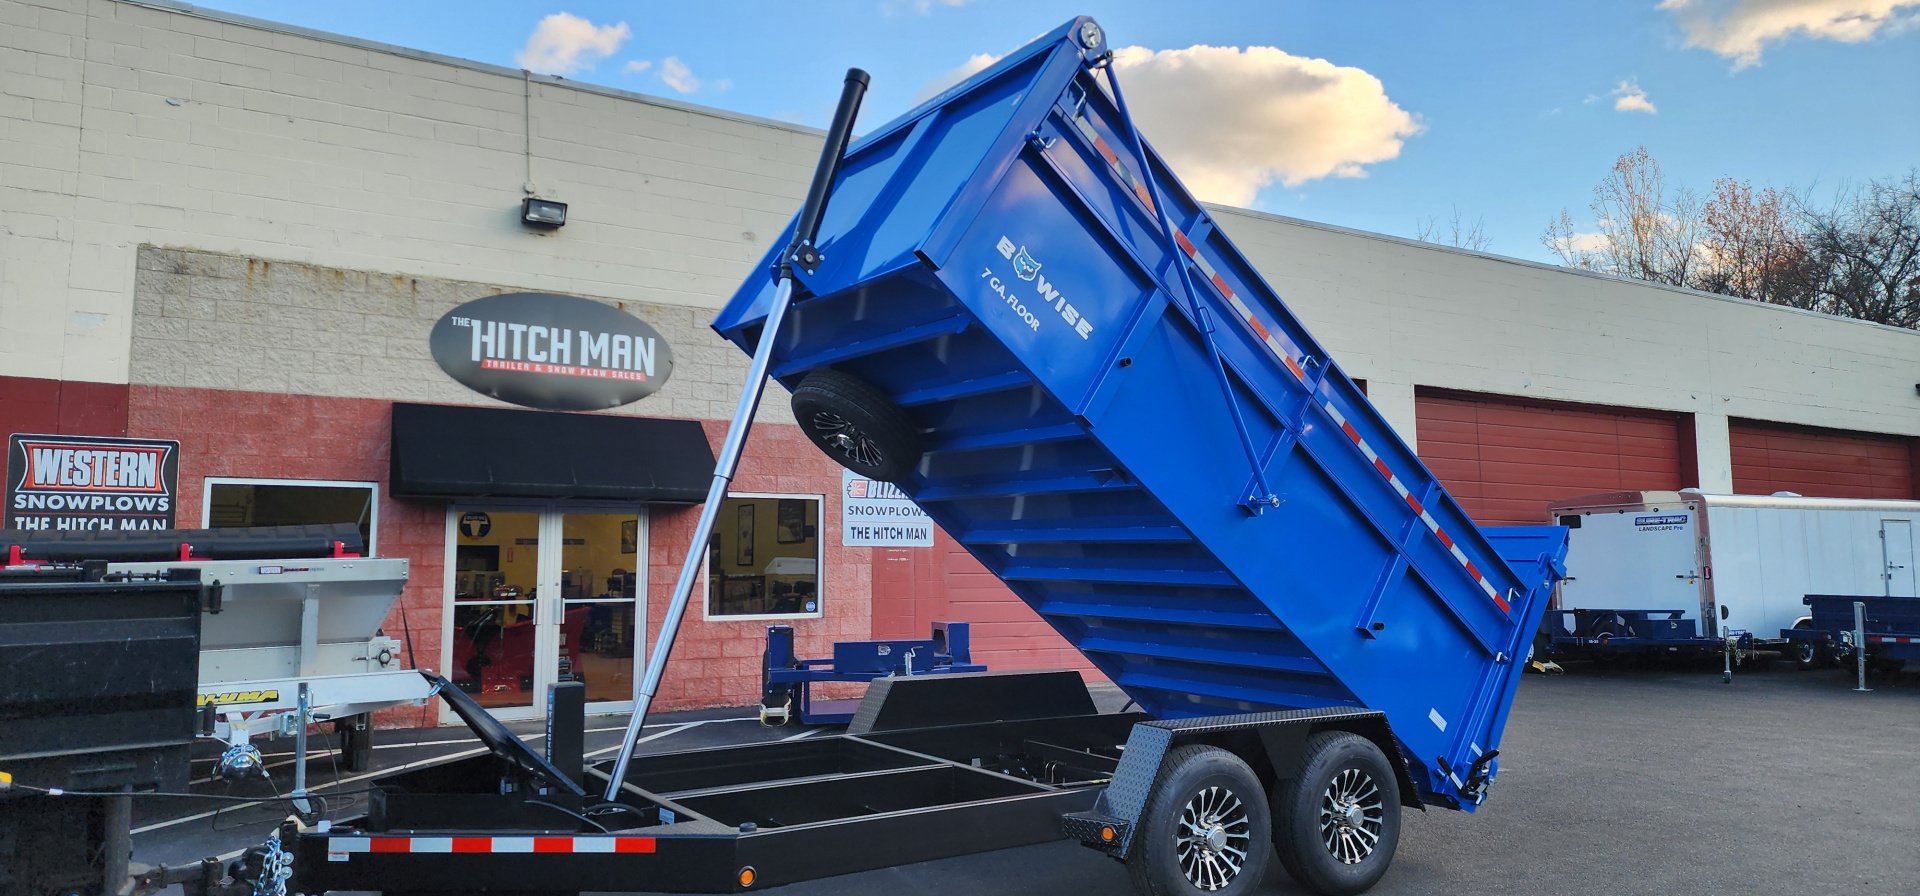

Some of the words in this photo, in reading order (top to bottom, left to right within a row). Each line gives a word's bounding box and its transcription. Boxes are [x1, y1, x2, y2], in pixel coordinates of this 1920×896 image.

[981, 267, 993, 279] 7
[989, 277, 1006, 300] GA.
[1006, 293, 1040, 332] FLOOR
[451, 316, 471, 327] THE
[470, 319, 572, 365] HITCH
[579, 330, 655, 376] MAN
[486, 359, 529, 371] TRAILER
[547, 365, 575, 374] SNOW
[580, 368, 607, 377] PLOW
[611, 370, 641, 380] SALES
[32, 447, 158, 488] WESTERN
[867, 481, 909, 499] BLIZ
[14, 495, 170, 512] SNOWPLOWS
[14, 516, 50, 531] THE
[56, 517, 114, 531] HITCH
[120, 518, 167, 531] MAN
[850, 526, 871, 540] THE
[873, 527, 903, 540] HITCH
[906, 528, 927, 540] MAN
